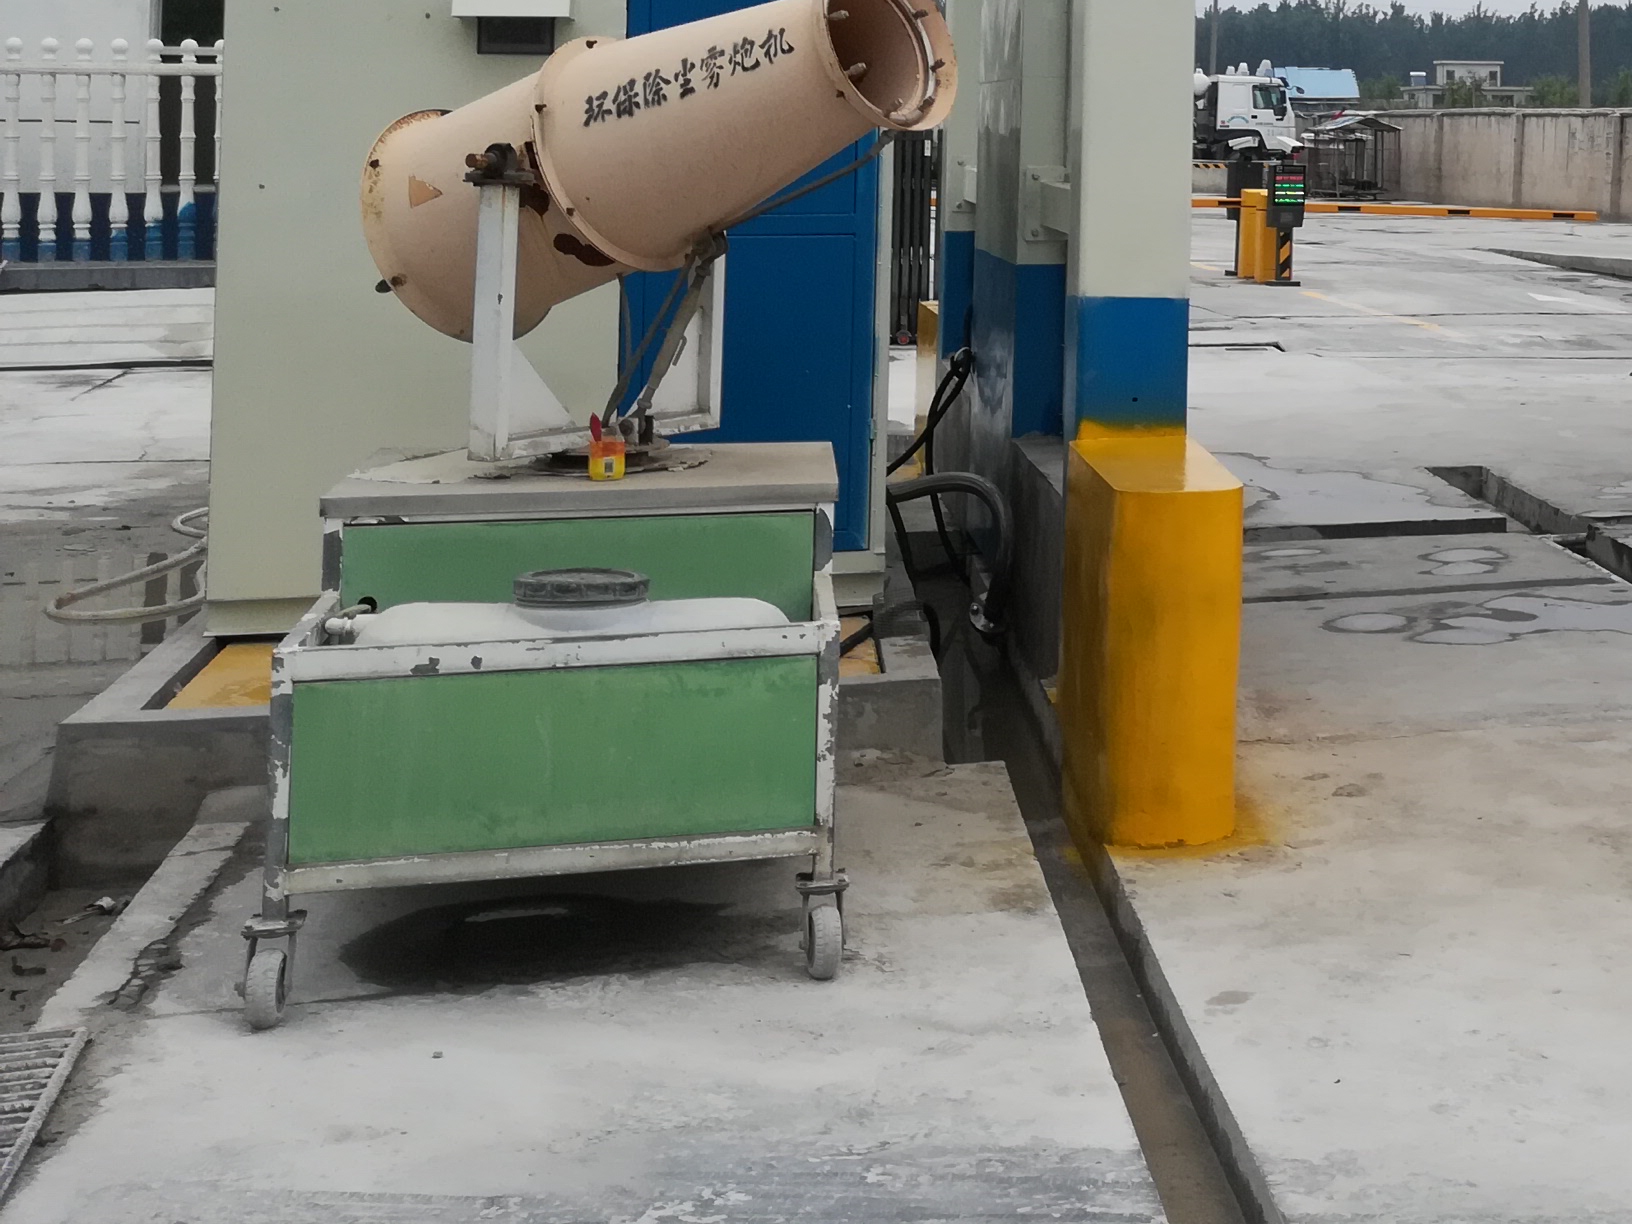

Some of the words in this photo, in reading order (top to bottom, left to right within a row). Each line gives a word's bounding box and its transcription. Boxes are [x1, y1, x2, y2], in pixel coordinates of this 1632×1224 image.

[583, 28, 795, 127] 环保除尘雾炮机
